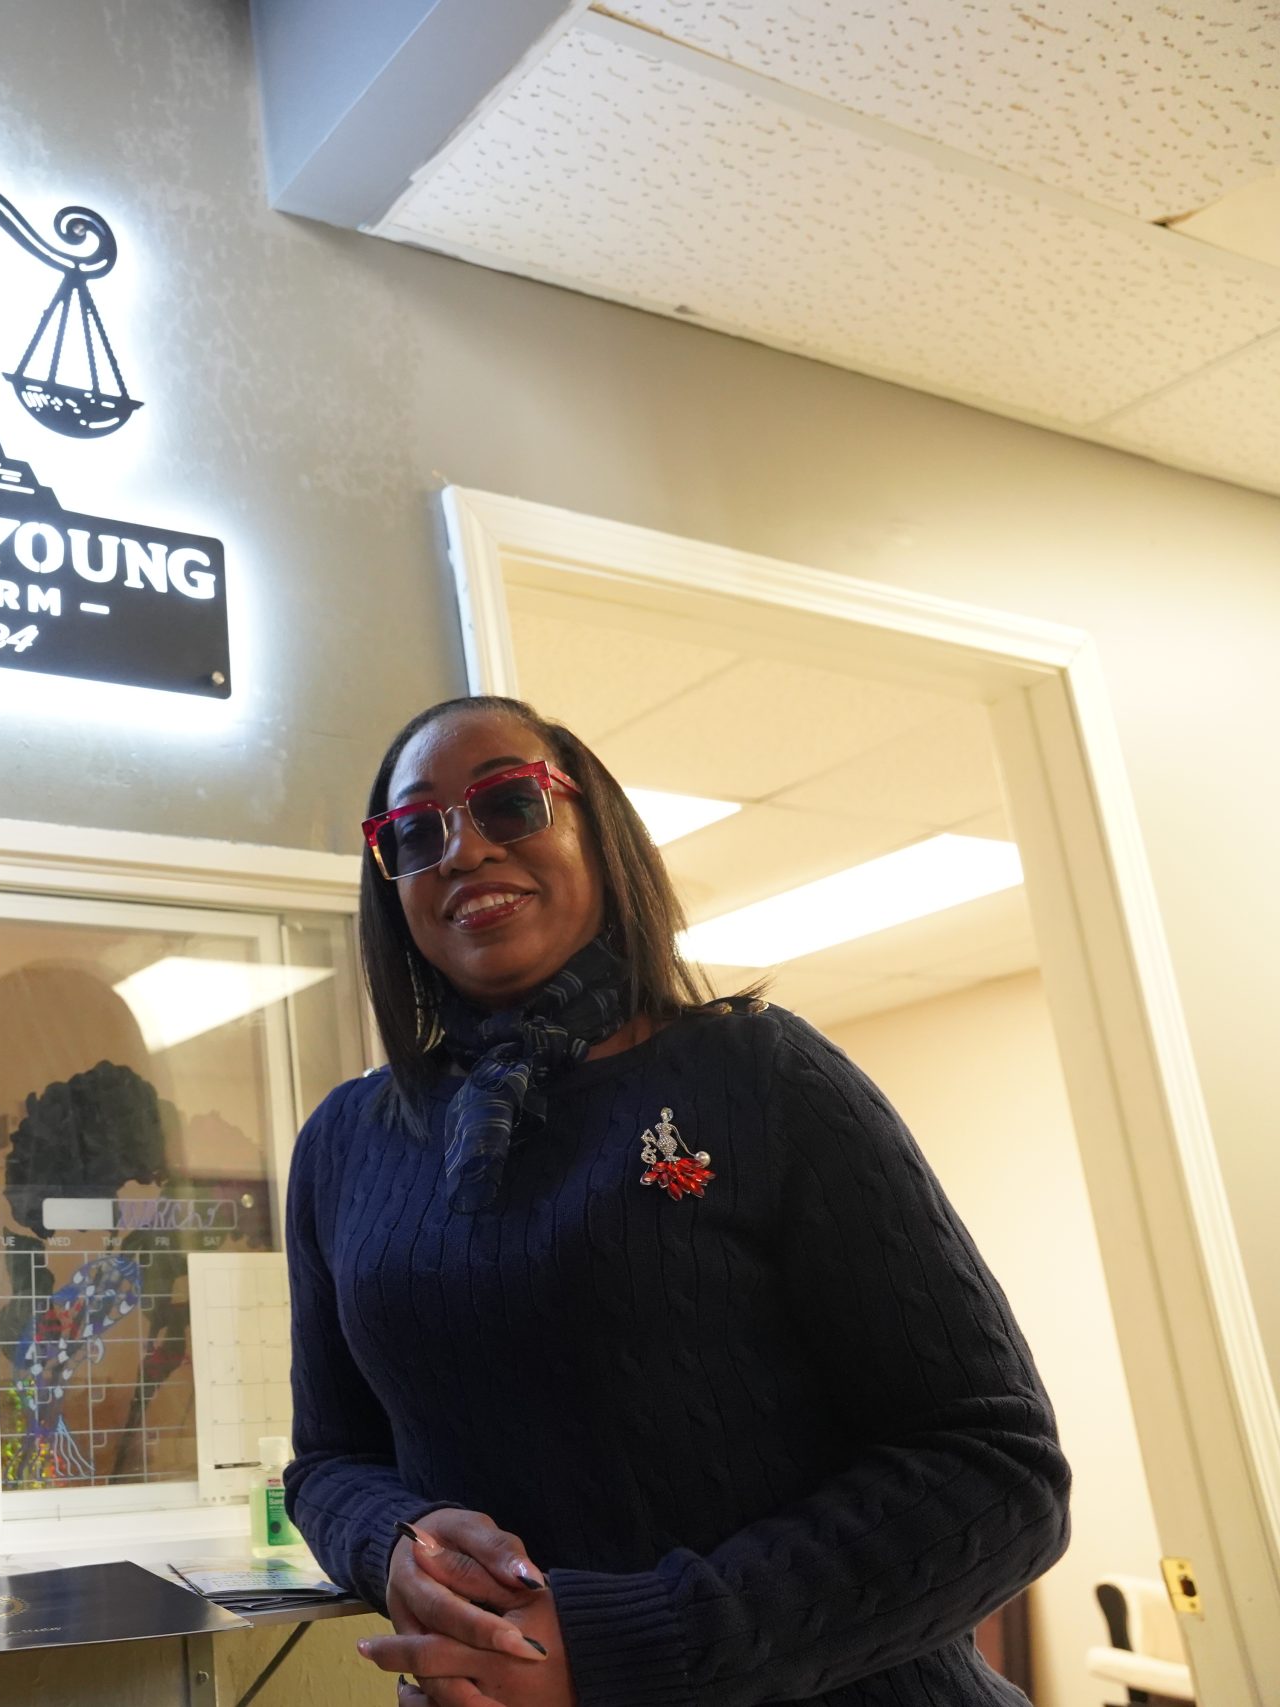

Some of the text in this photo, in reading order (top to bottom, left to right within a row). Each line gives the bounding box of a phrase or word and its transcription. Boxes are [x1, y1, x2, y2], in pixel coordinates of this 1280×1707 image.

[46, 1236, 71, 1247] WED
[102, 1235, 123, 1247] THU
[154, 1235, 171, 1247] FRI
[203, 1235, 221, 1247] SAT
